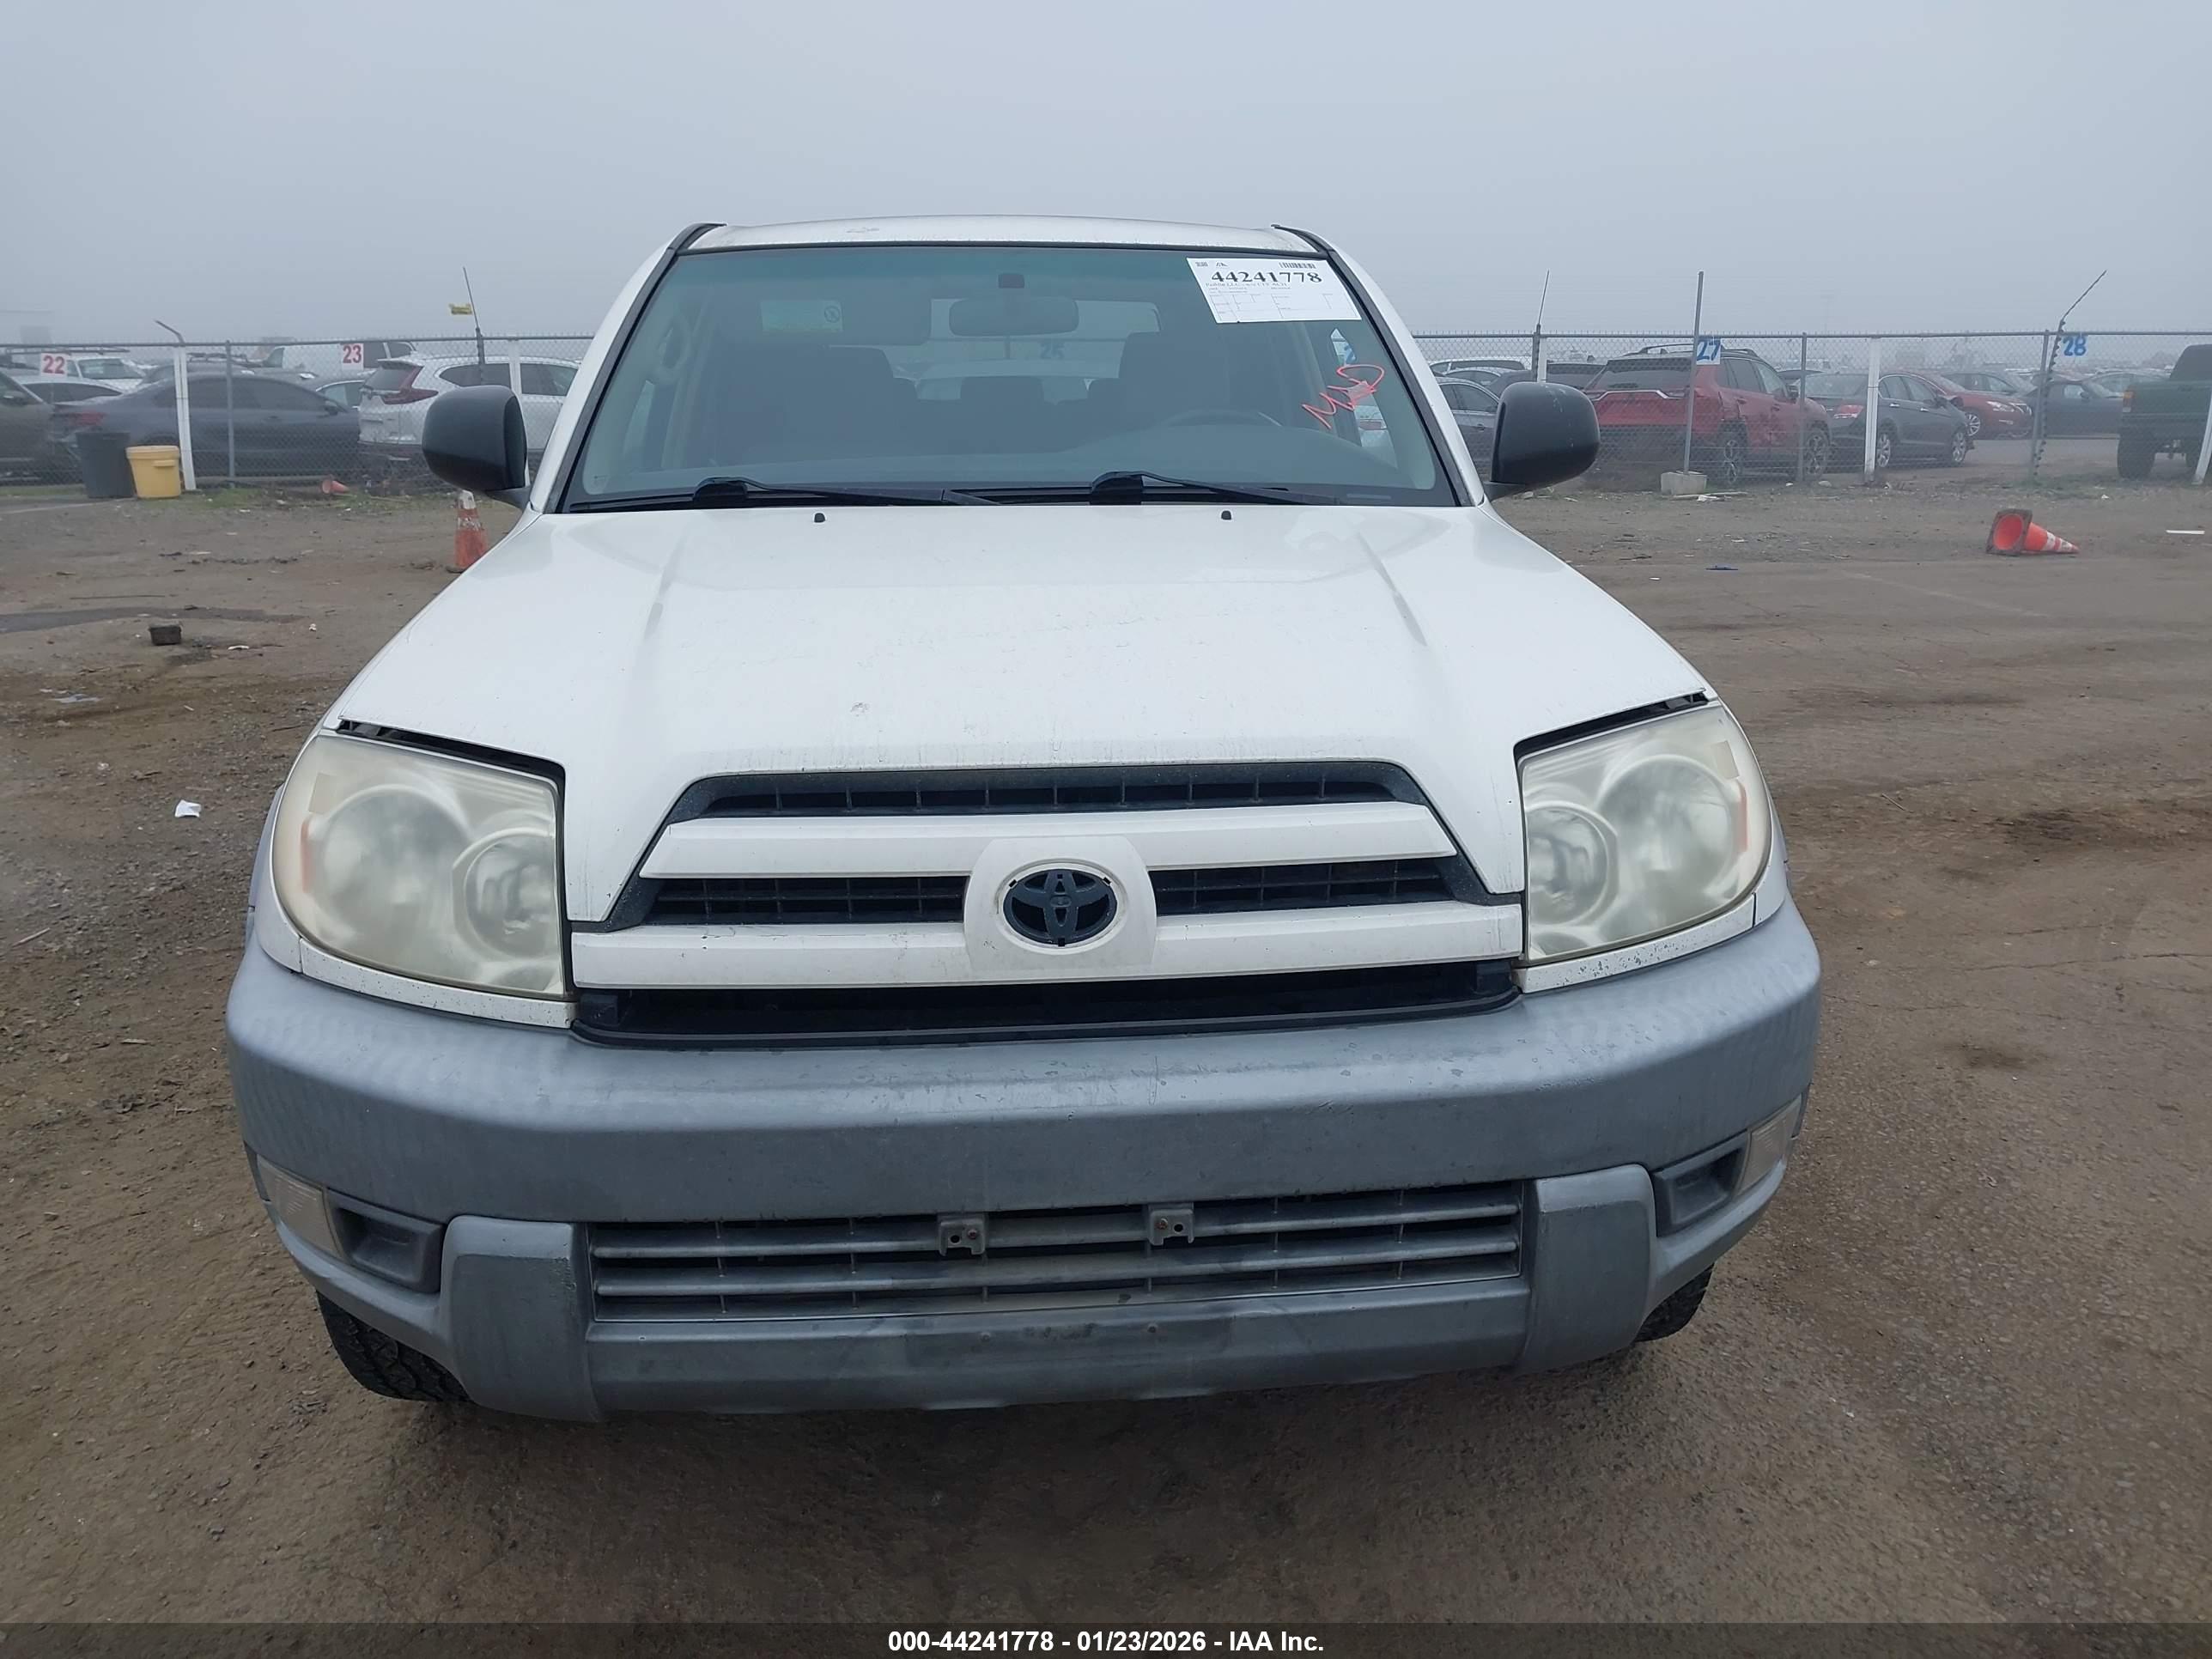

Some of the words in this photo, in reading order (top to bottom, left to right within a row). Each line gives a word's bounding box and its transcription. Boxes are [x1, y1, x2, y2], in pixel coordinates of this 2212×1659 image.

[1211, 270, 1322, 283] 44241778
[343, 344, 362, 364] 23
[1696, 338, 1721, 361] 27
[2063, 335, 2087, 356] 28
[43, 355, 65, 374] 22
